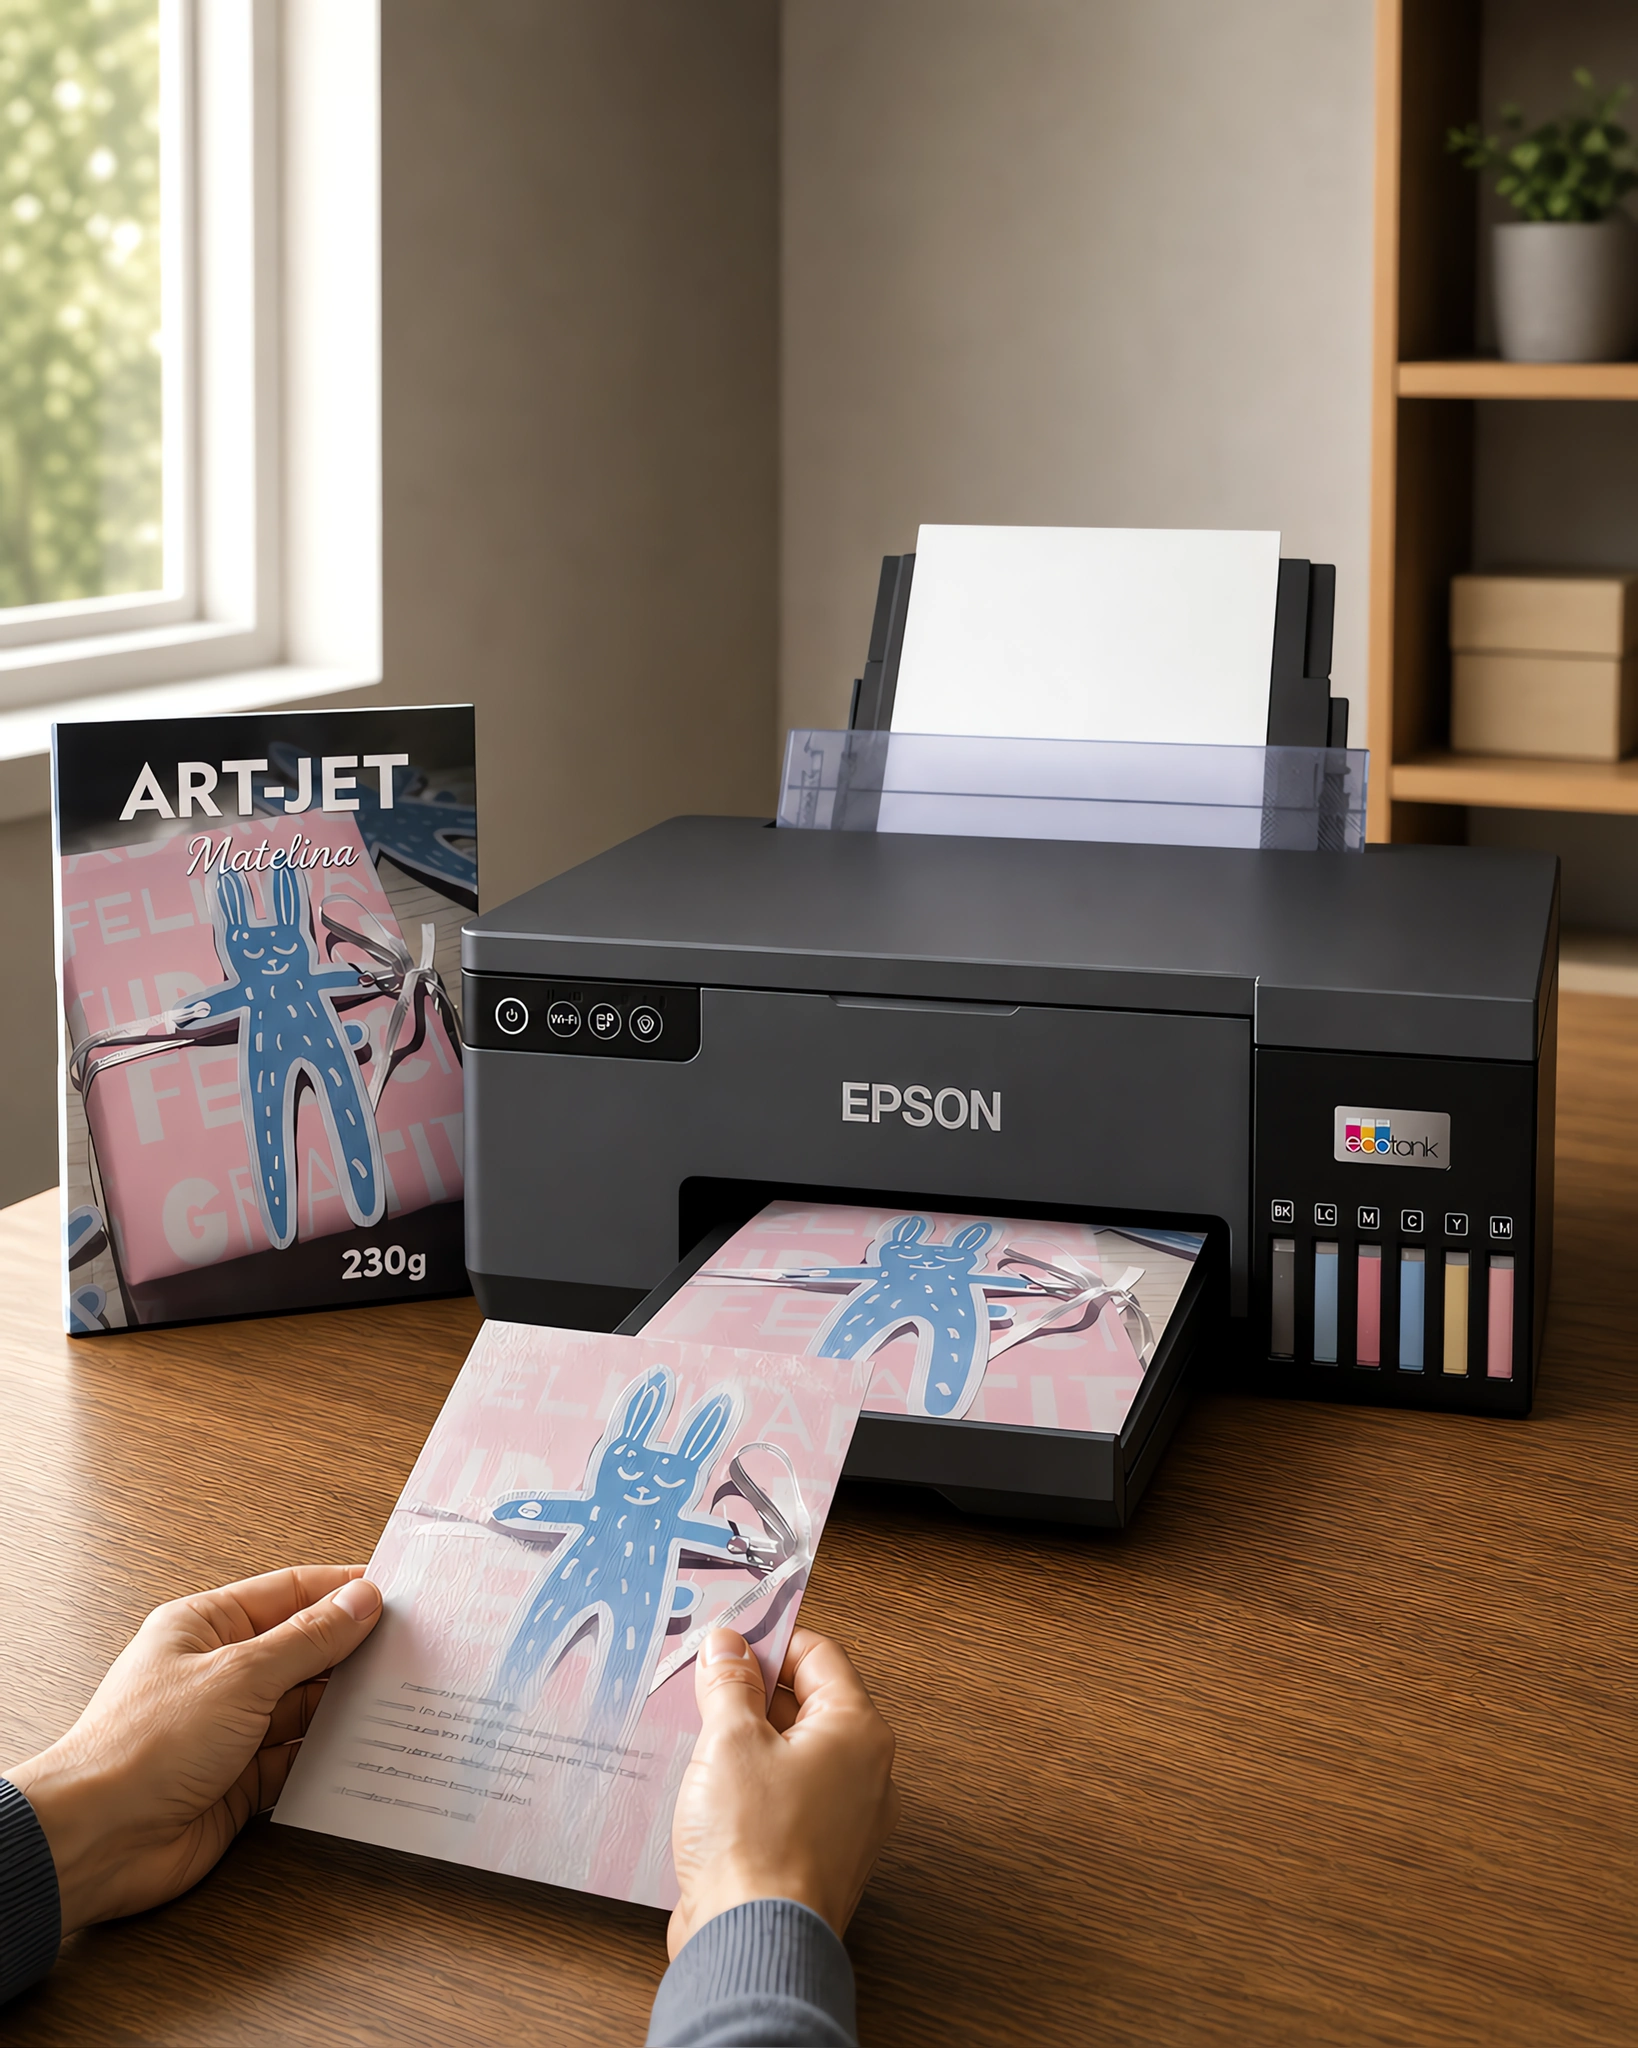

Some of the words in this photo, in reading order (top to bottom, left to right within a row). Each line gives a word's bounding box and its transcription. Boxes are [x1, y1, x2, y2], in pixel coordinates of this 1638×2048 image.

[119, 753, 409, 821] ART-JET
[186, 833, 360, 876] Matelina
[842, 1081, 1001, 1132] EPSON
[1345, 1135, 1439, 1159] ecotank
[1274, 1204, 1291, 1218] BK
[1317, 1208, 1334, 1222] LC
[1362, 1211, 1375, 1225] M
[1407, 1215, 1418, 1228] C
[1452, 1218, 1462, 1231] Y
[1492, 1221, 1511, 1235] LM
[341, 1244, 427, 1282] 230g
